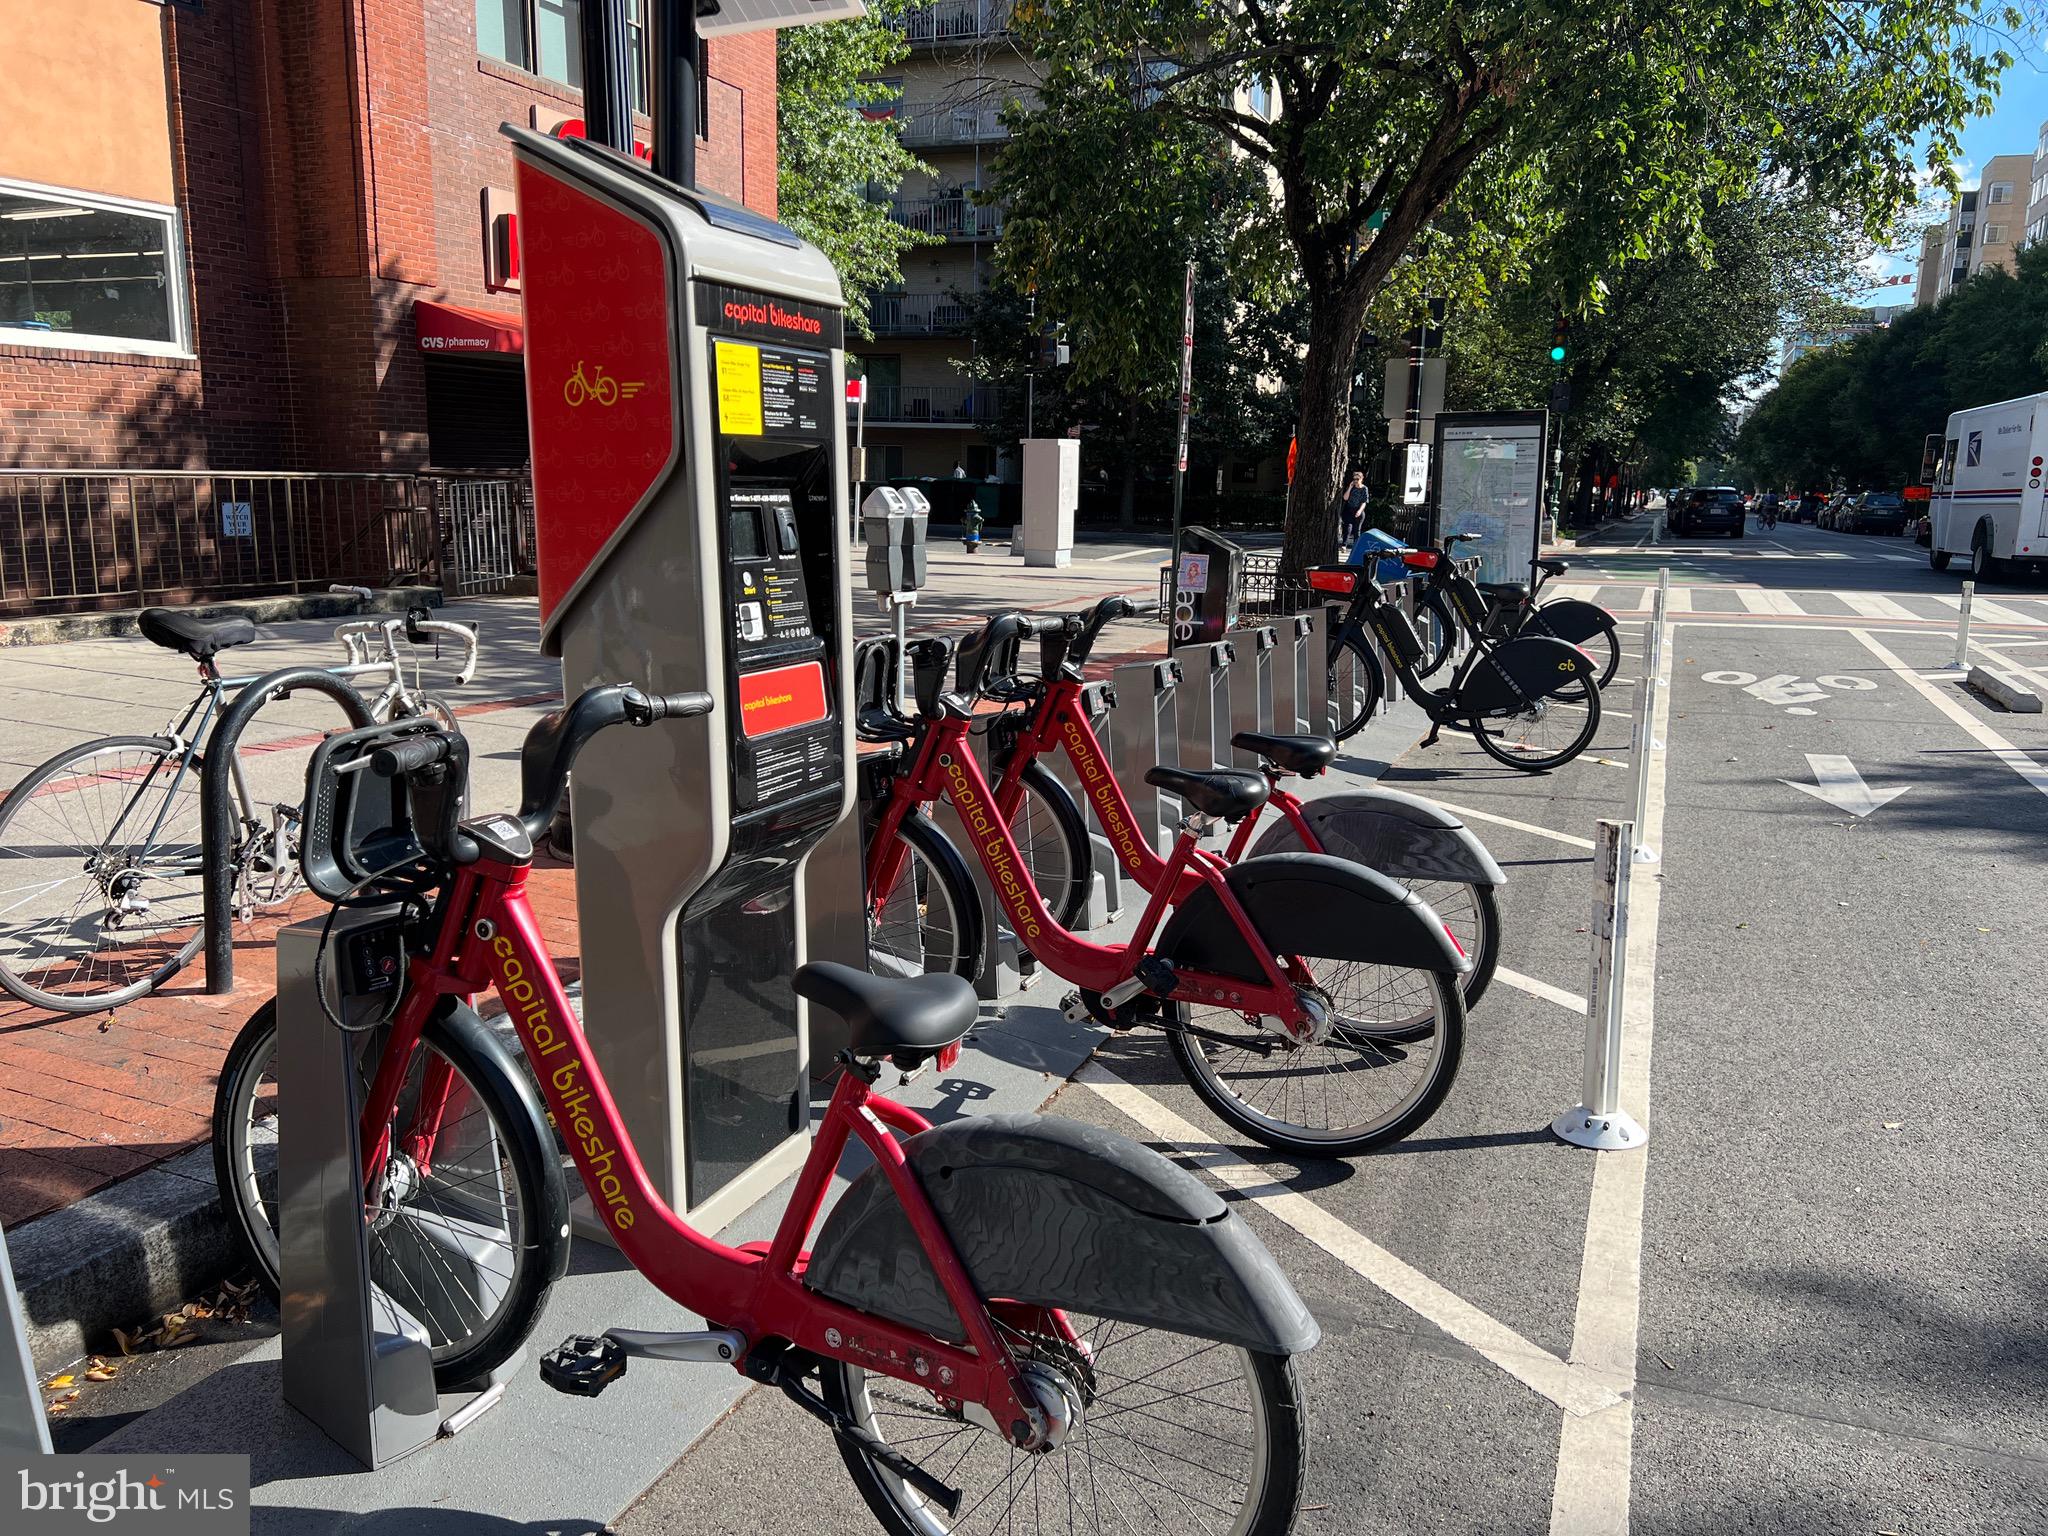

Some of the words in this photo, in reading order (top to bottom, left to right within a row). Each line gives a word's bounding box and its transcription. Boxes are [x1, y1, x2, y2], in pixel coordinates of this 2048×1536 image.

[724, 302, 767, 325] capital
[769, 302, 821, 335] bikeshare
[421, 336, 490, 349] CVS/pharmacy
[1411, 450, 1424, 463] ONE
[1411, 465, 1425, 478] WAY
[1174, 591, 1205, 641] ade
[743, 697, 765, 711] capital
[1064, 721, 1105, 783] capital
[1096, 782, 1141, 869] bikeshare
[948, 764, 996, 837] capital
[986, 836, 1041, 939] bikeshare
[492, 935, 567, 1057] capital
[552, 1058, 635, 1231] bikeshare
